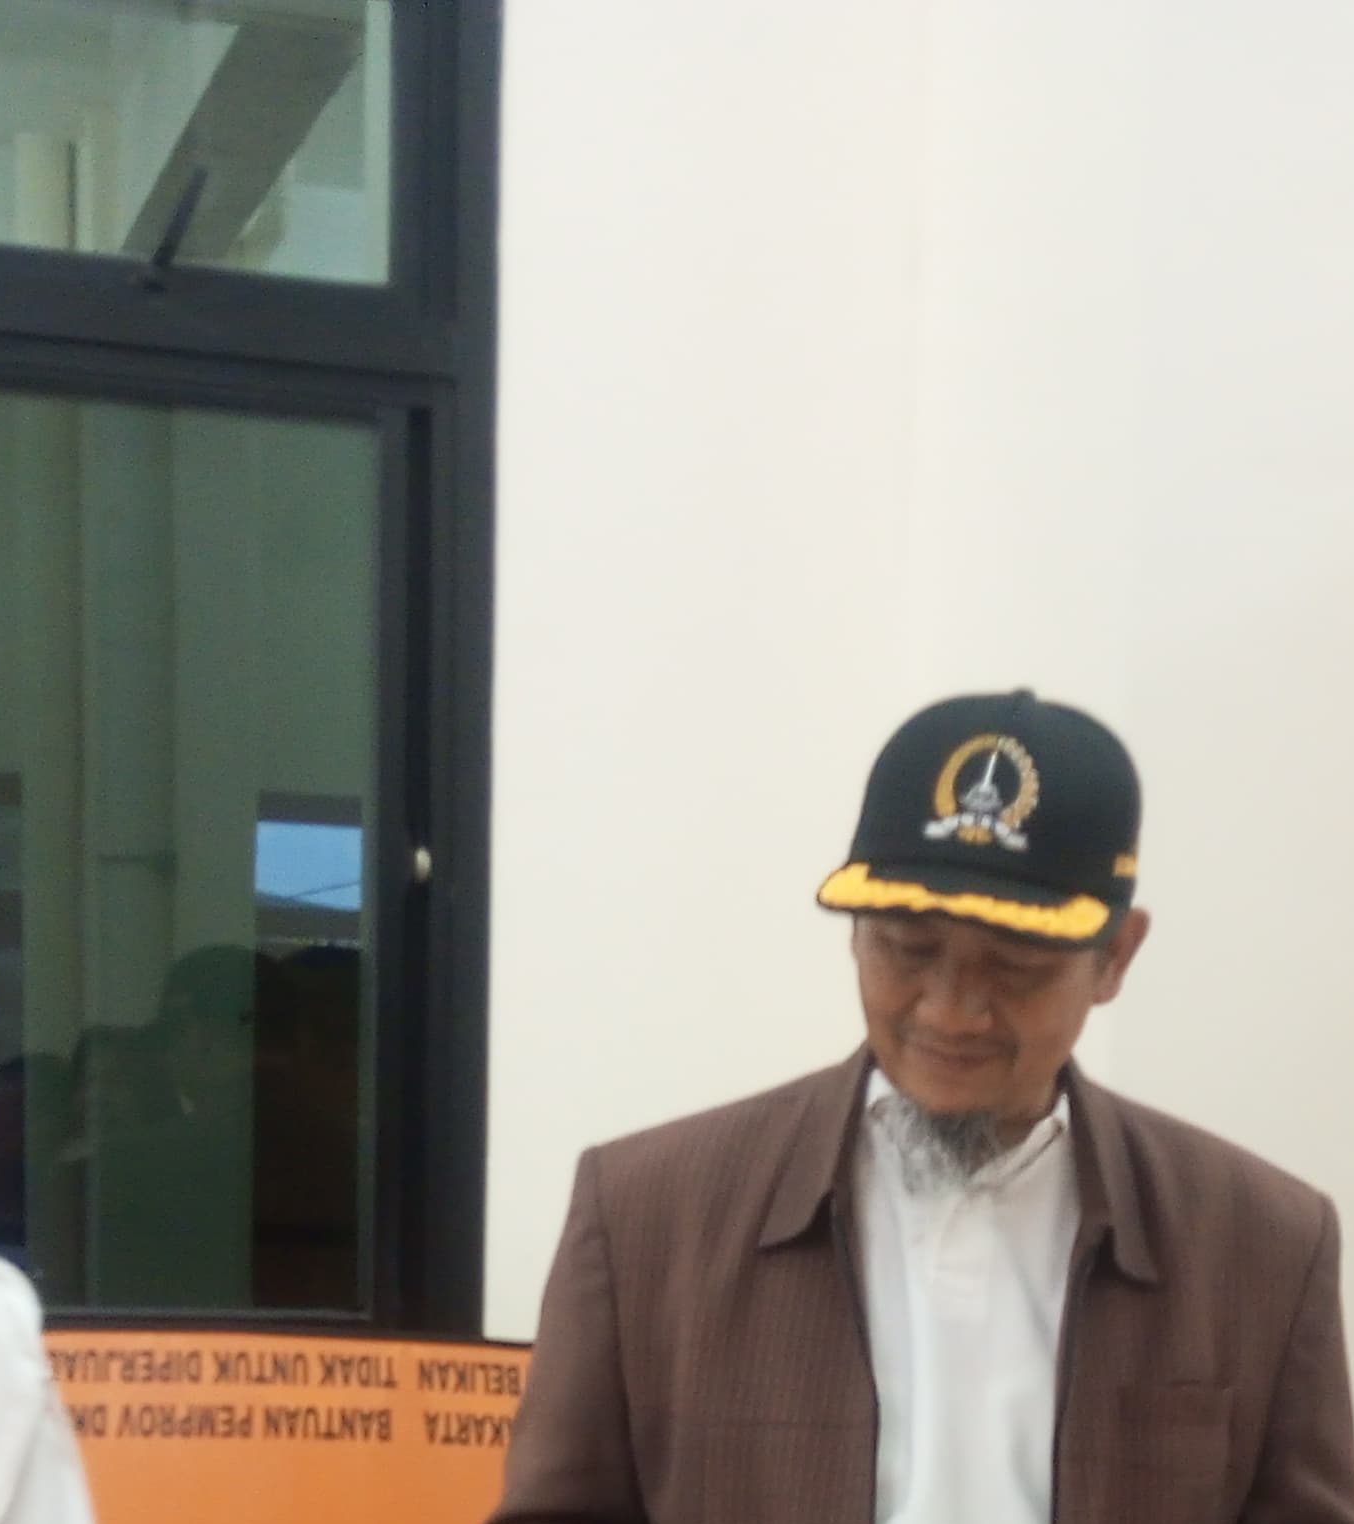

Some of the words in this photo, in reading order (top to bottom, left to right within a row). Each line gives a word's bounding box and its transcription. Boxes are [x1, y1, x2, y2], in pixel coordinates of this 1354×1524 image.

[214, 1350, 309, 1386] UNTUK
[319, 1352, 397, 1388] TIDAK
[418, 1357, 521, 1396] BELIKAN
[116, 1404, 252, 1439] PEMPROV
[264, 1404, 393, 1442] BANTUAN
